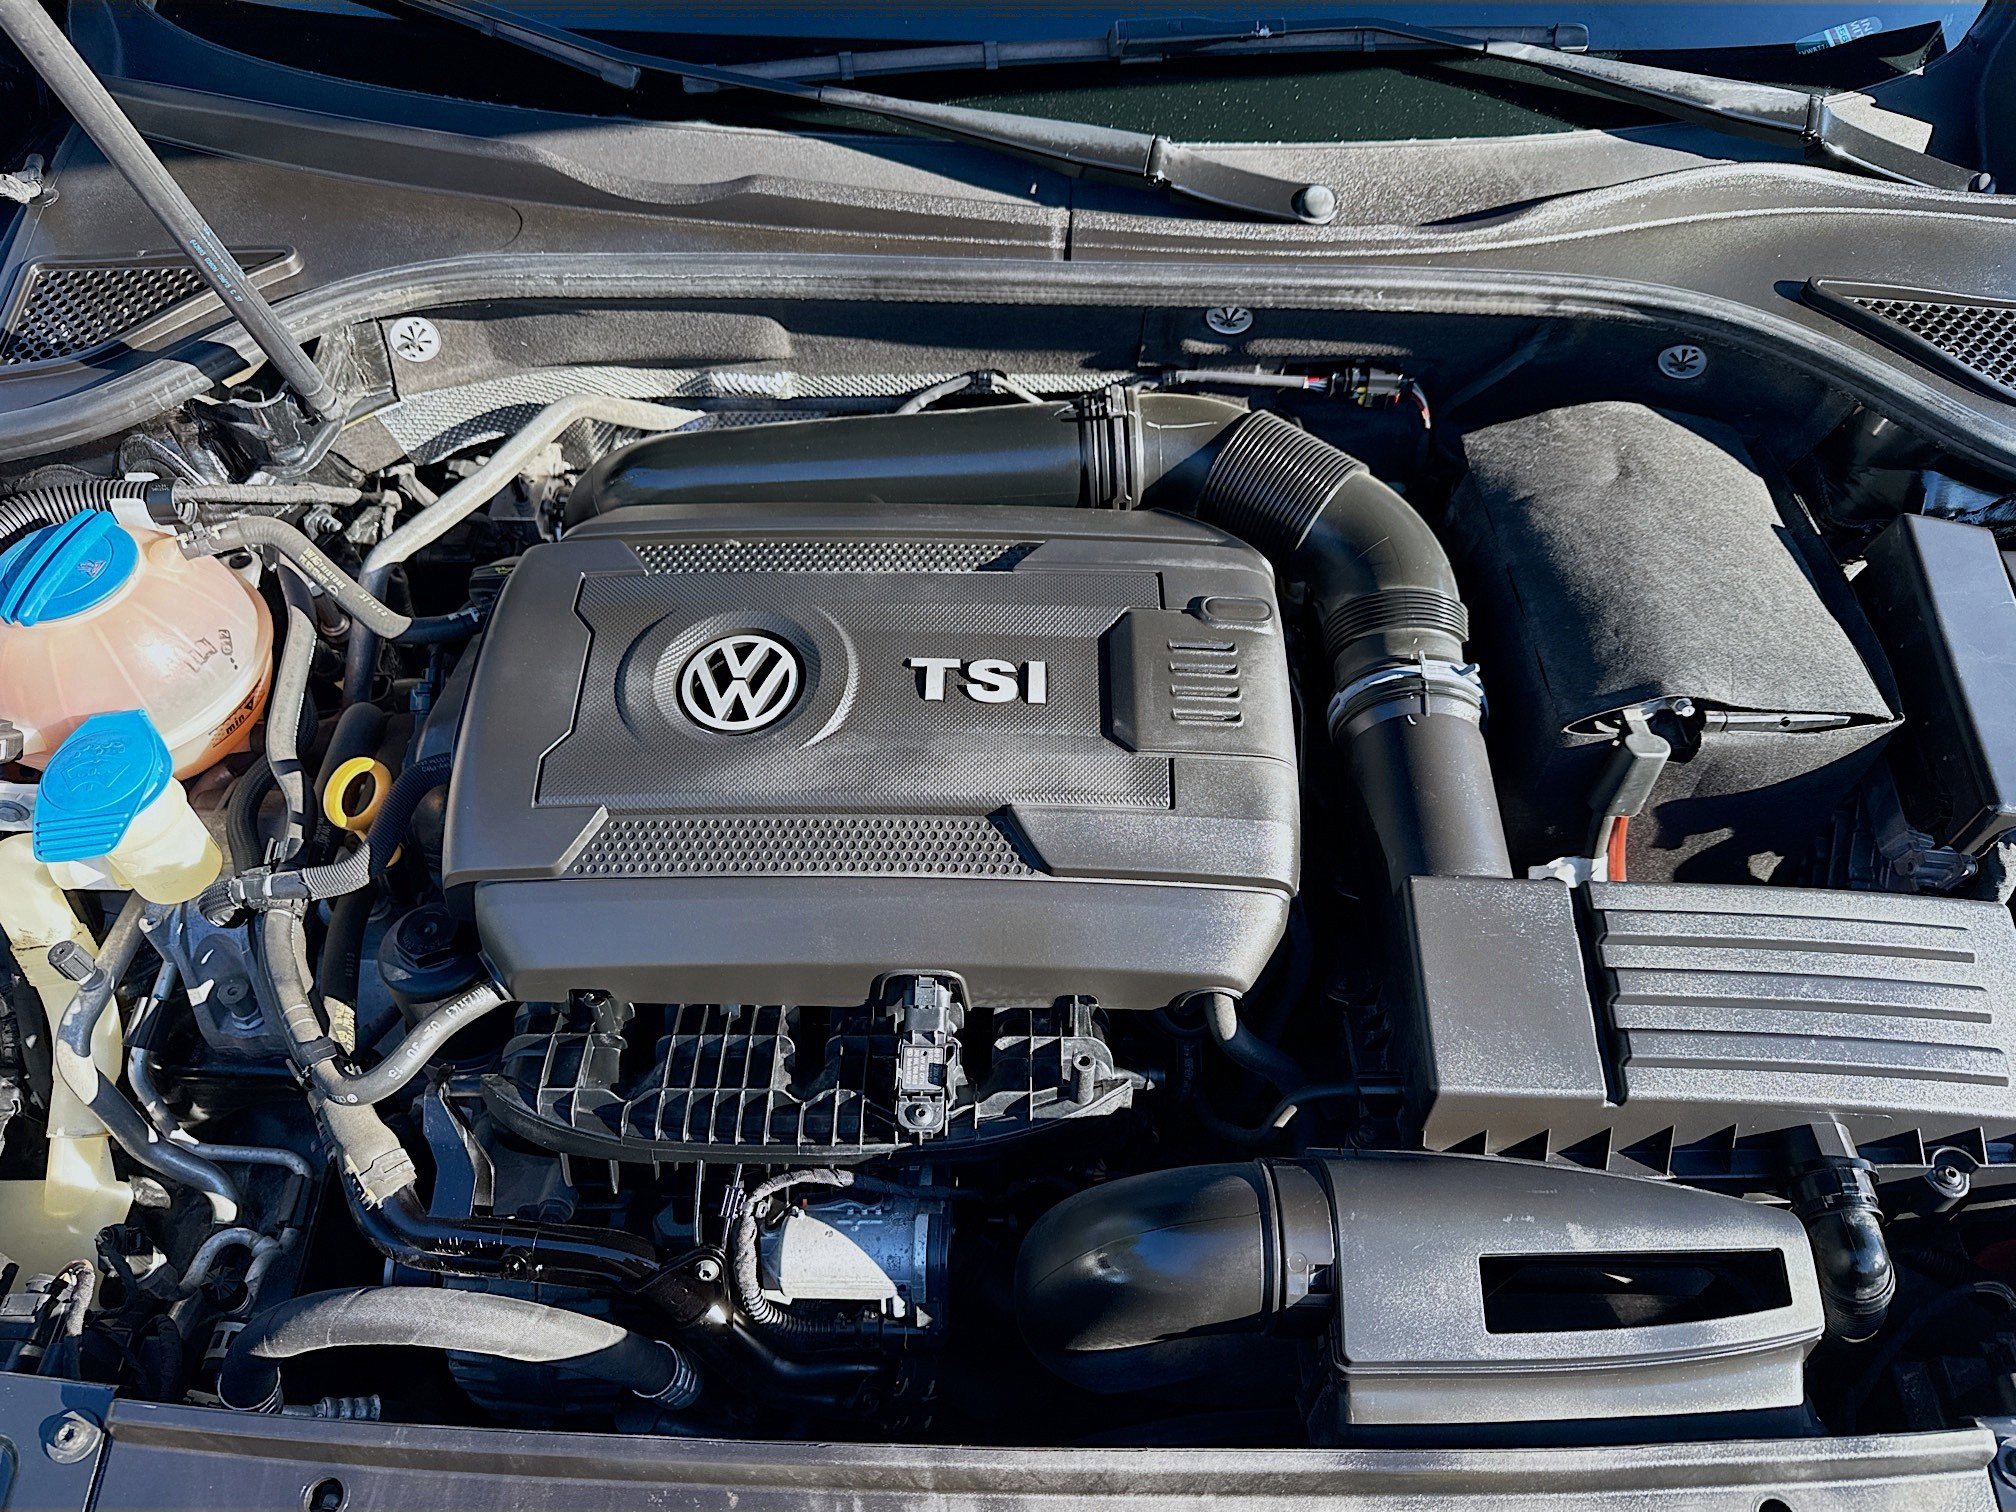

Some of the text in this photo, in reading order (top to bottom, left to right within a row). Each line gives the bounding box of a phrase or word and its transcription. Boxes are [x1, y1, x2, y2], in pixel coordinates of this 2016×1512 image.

[681, 634, 799, 731] VW
[910, 657, 1048, 704] TSI
[225, 714, 245, 735] min
